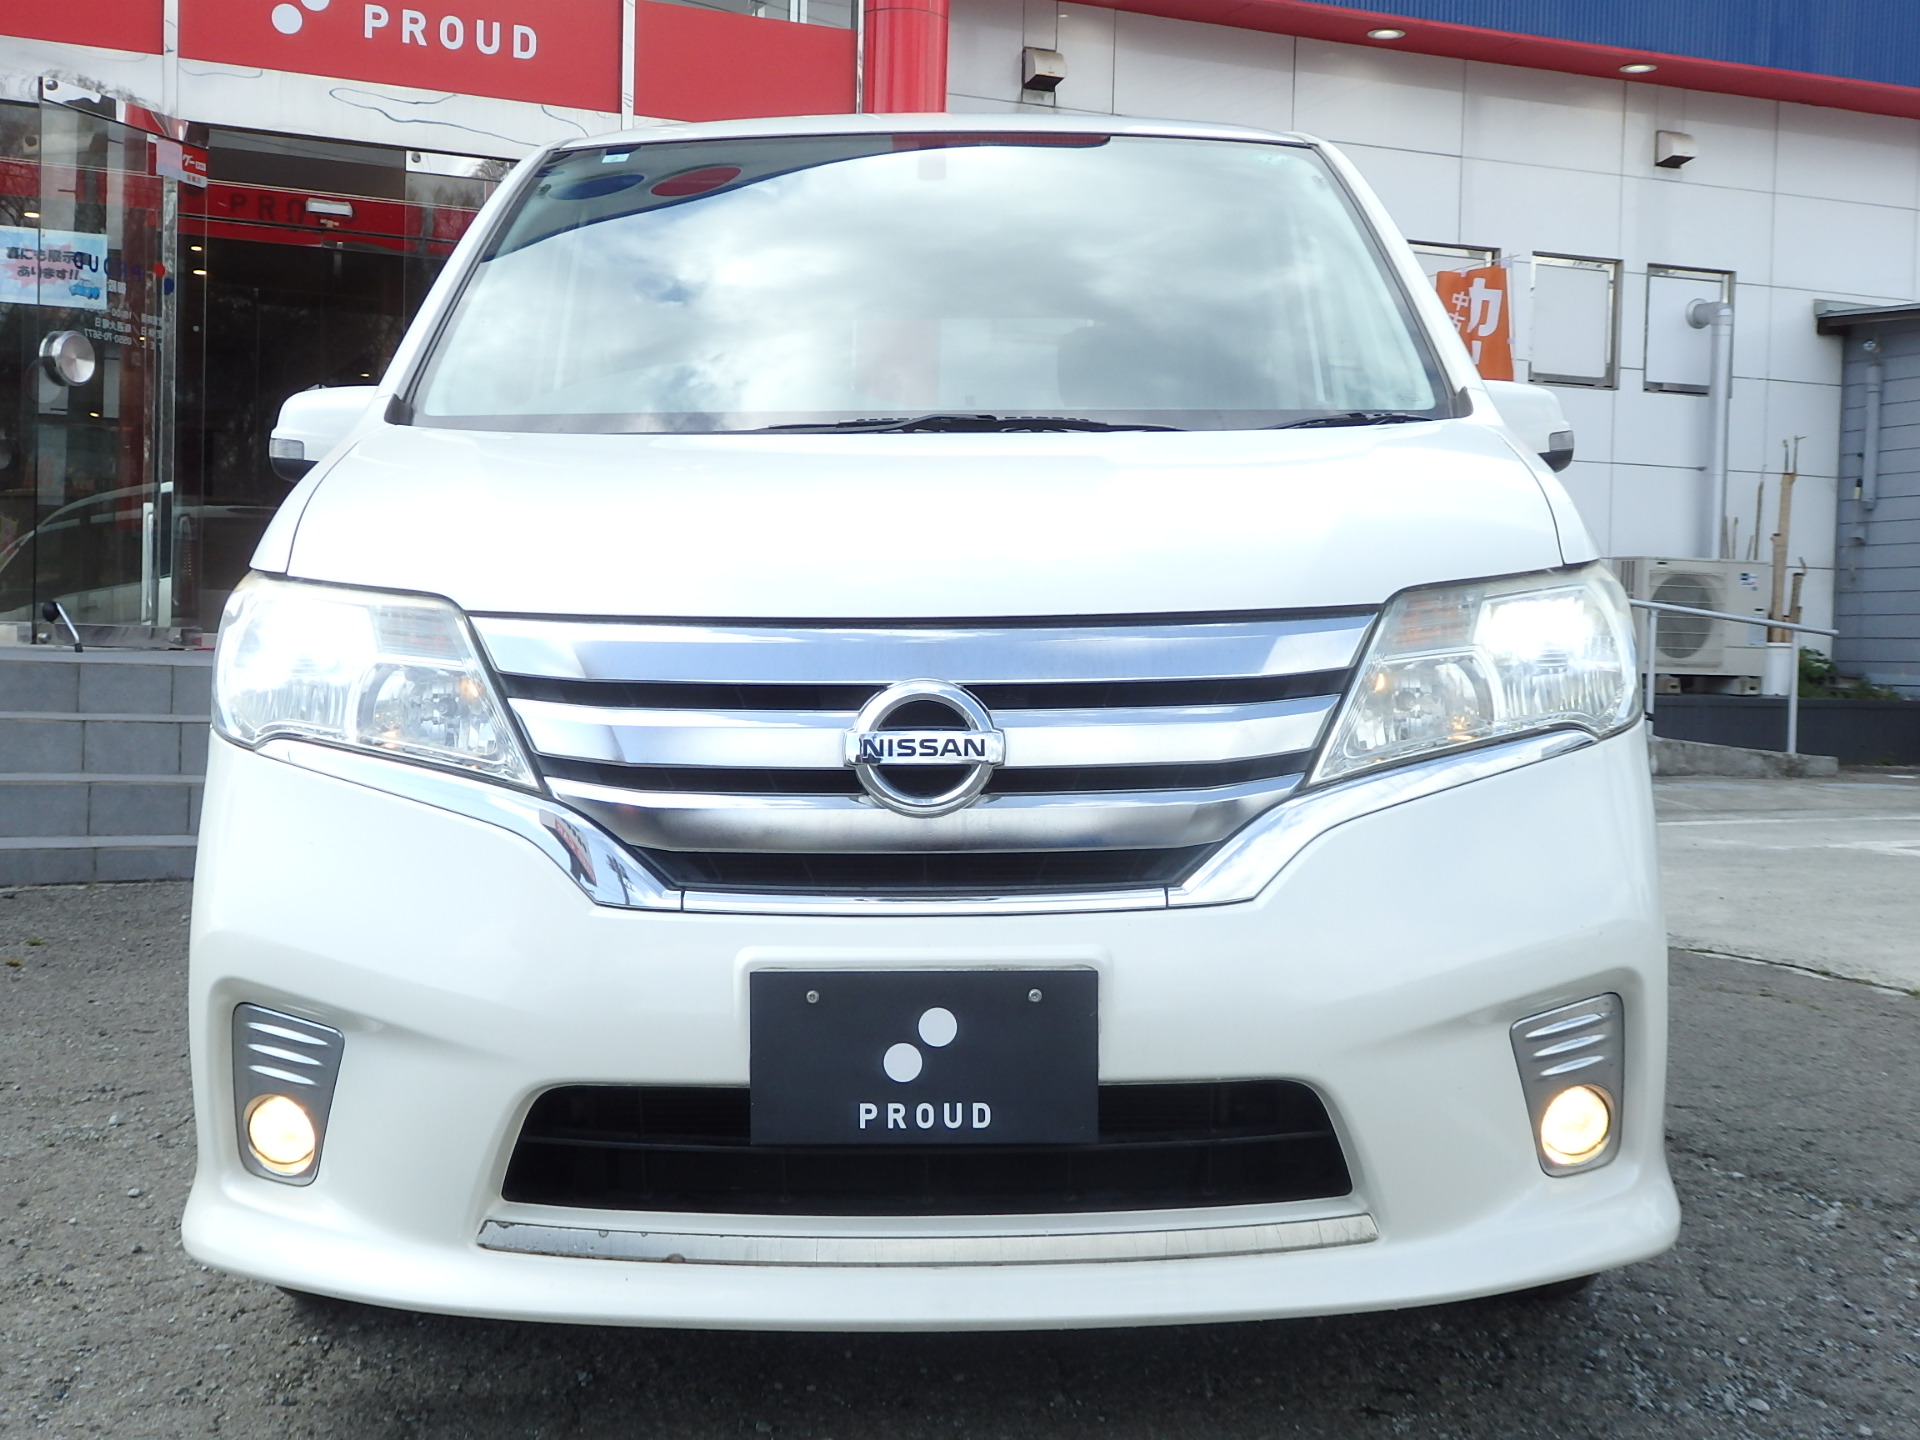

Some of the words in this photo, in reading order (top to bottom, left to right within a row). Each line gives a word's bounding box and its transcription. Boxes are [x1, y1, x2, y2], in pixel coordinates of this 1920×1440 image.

[364, 4, 537, 60] PROUD
[861, 737, 987, 758] NISSAN
[858, 1102, 992, 1130] PROUD
